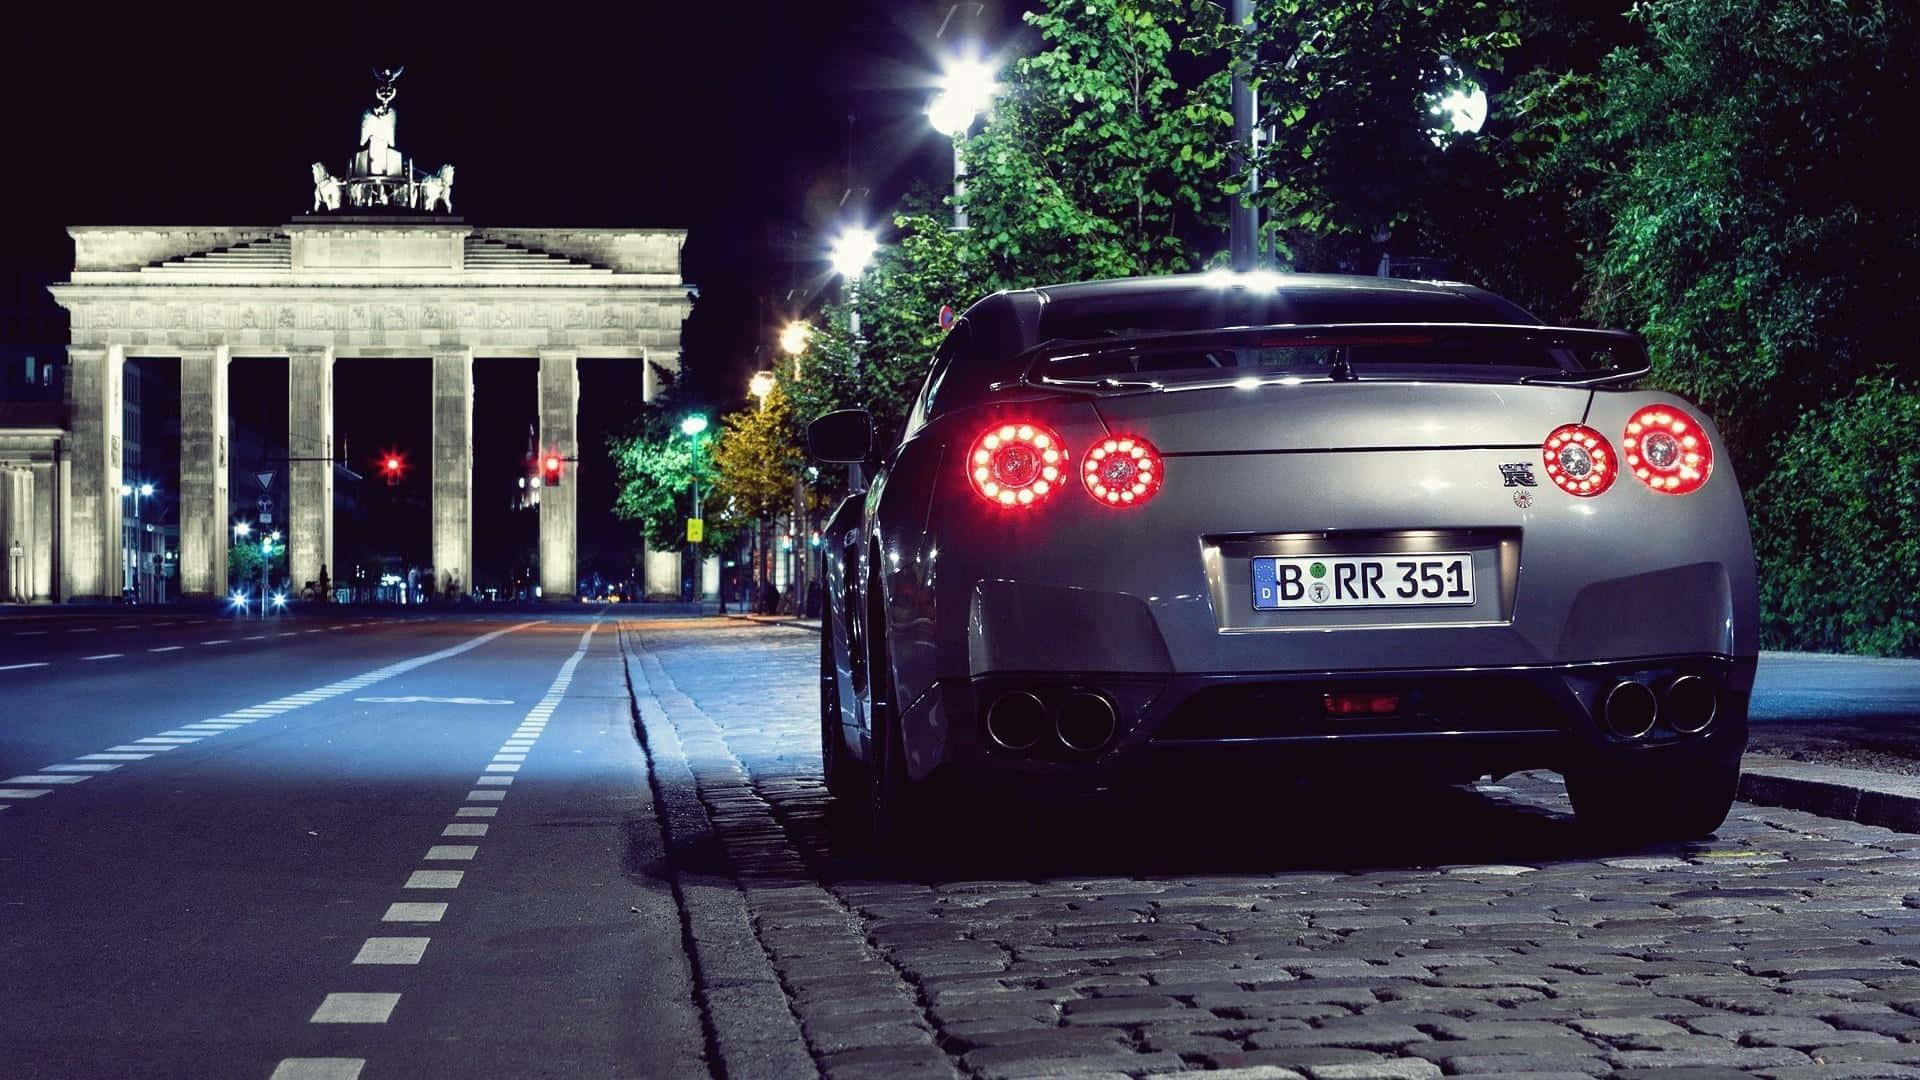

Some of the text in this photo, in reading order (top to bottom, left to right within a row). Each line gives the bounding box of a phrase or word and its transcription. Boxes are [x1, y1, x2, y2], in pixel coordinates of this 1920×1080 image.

[1279, 560, 1470, 601] B RR 351
[1263, 589, 1270, 599] D
